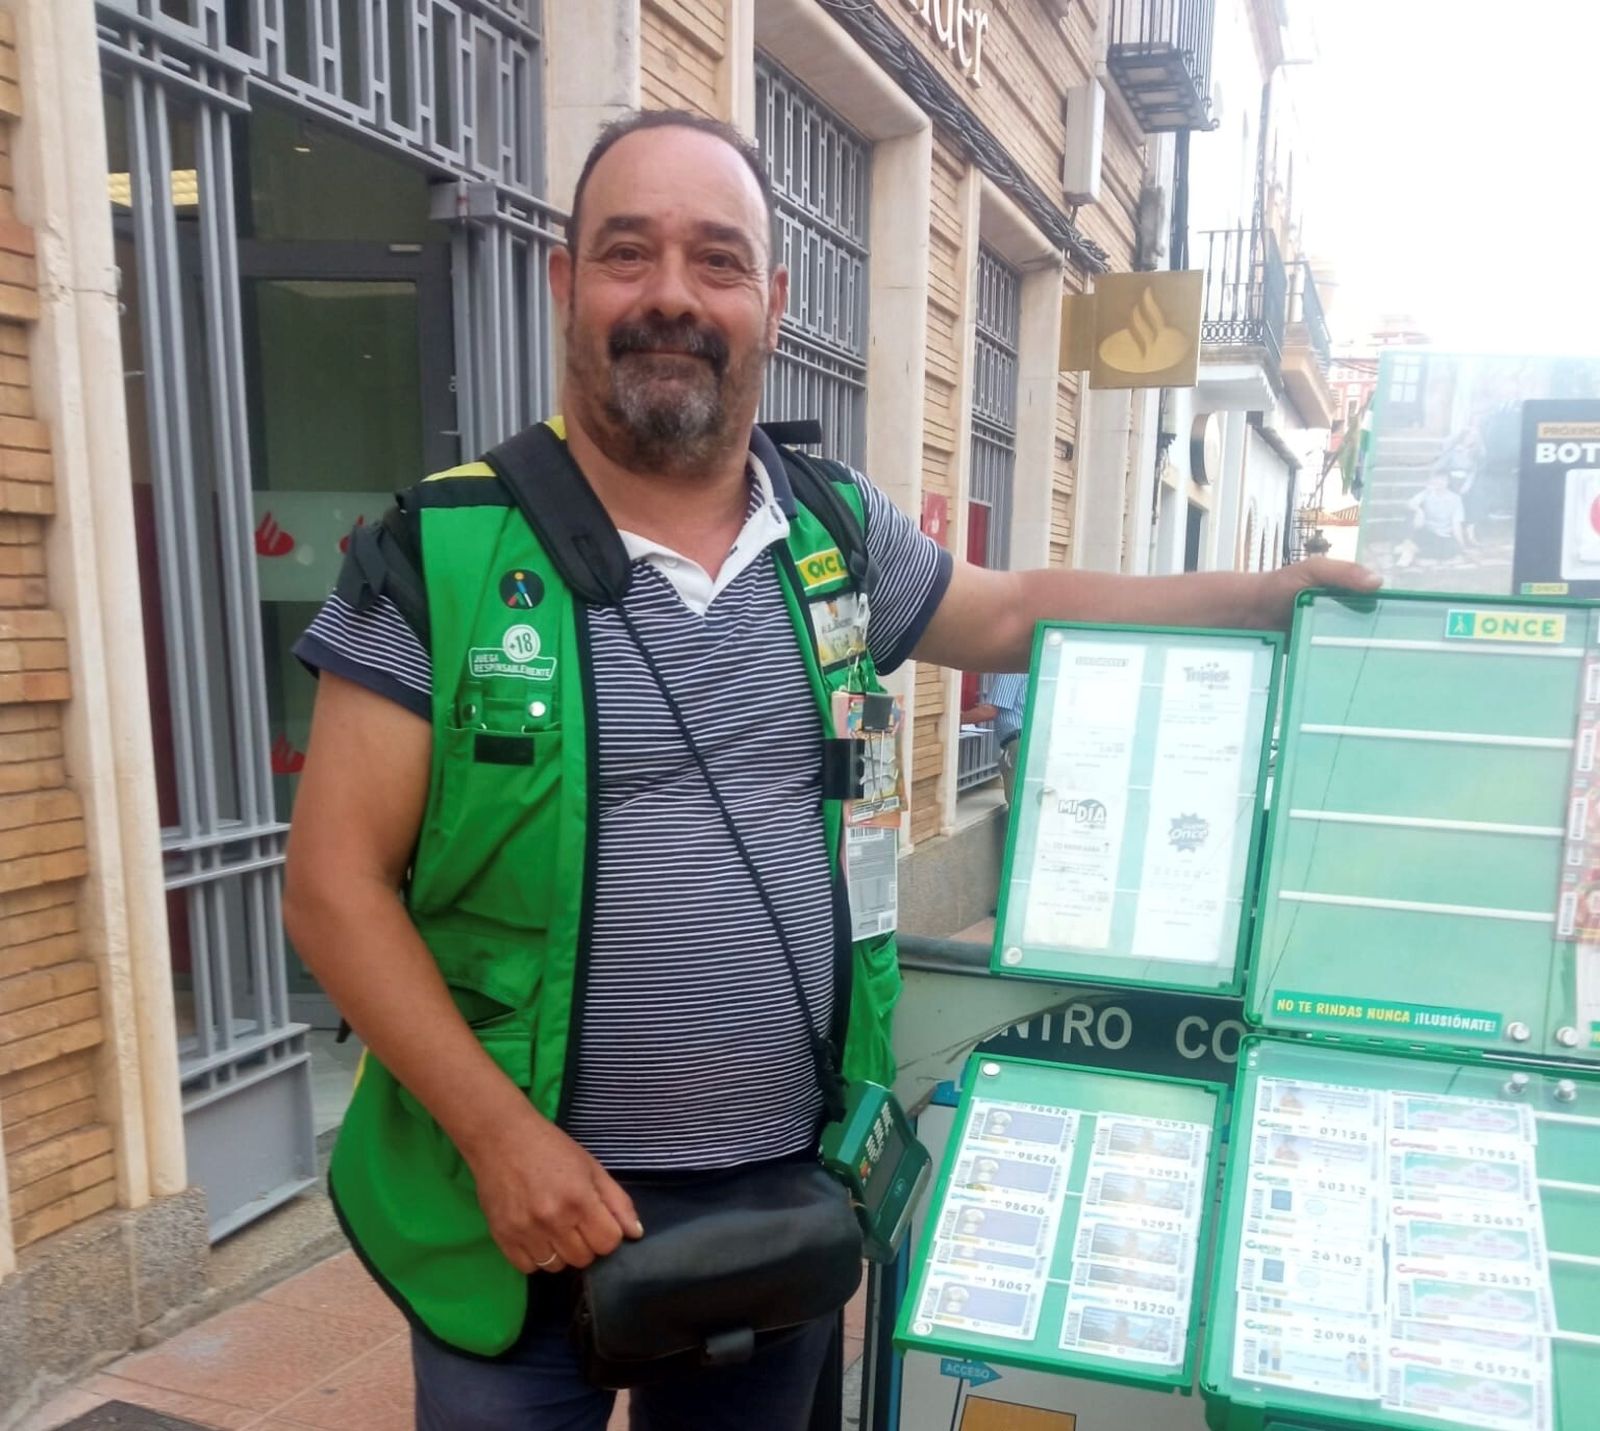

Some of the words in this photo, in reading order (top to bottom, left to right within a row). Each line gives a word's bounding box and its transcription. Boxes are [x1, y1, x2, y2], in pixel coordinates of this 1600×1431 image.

[1535, 442, 1600, 464] BOT
[1481, 617, 1557, 637] ONCE
[509, 632, 533, 655] +18
[1277, 999, 1294, 1011] NO
[1298, 1000, 1312, 1013] TE
[1316, 1002, 1362, 1019] RINDAS
[1367, 1007, 1410, 1023] NUNCA
[1414, 1013, 1496, 1033] ¡ILUSIÓNATE!
[1133, 1300, 1176, 1317] 15720
[945, 1363, 991, 1379] ACCESO
